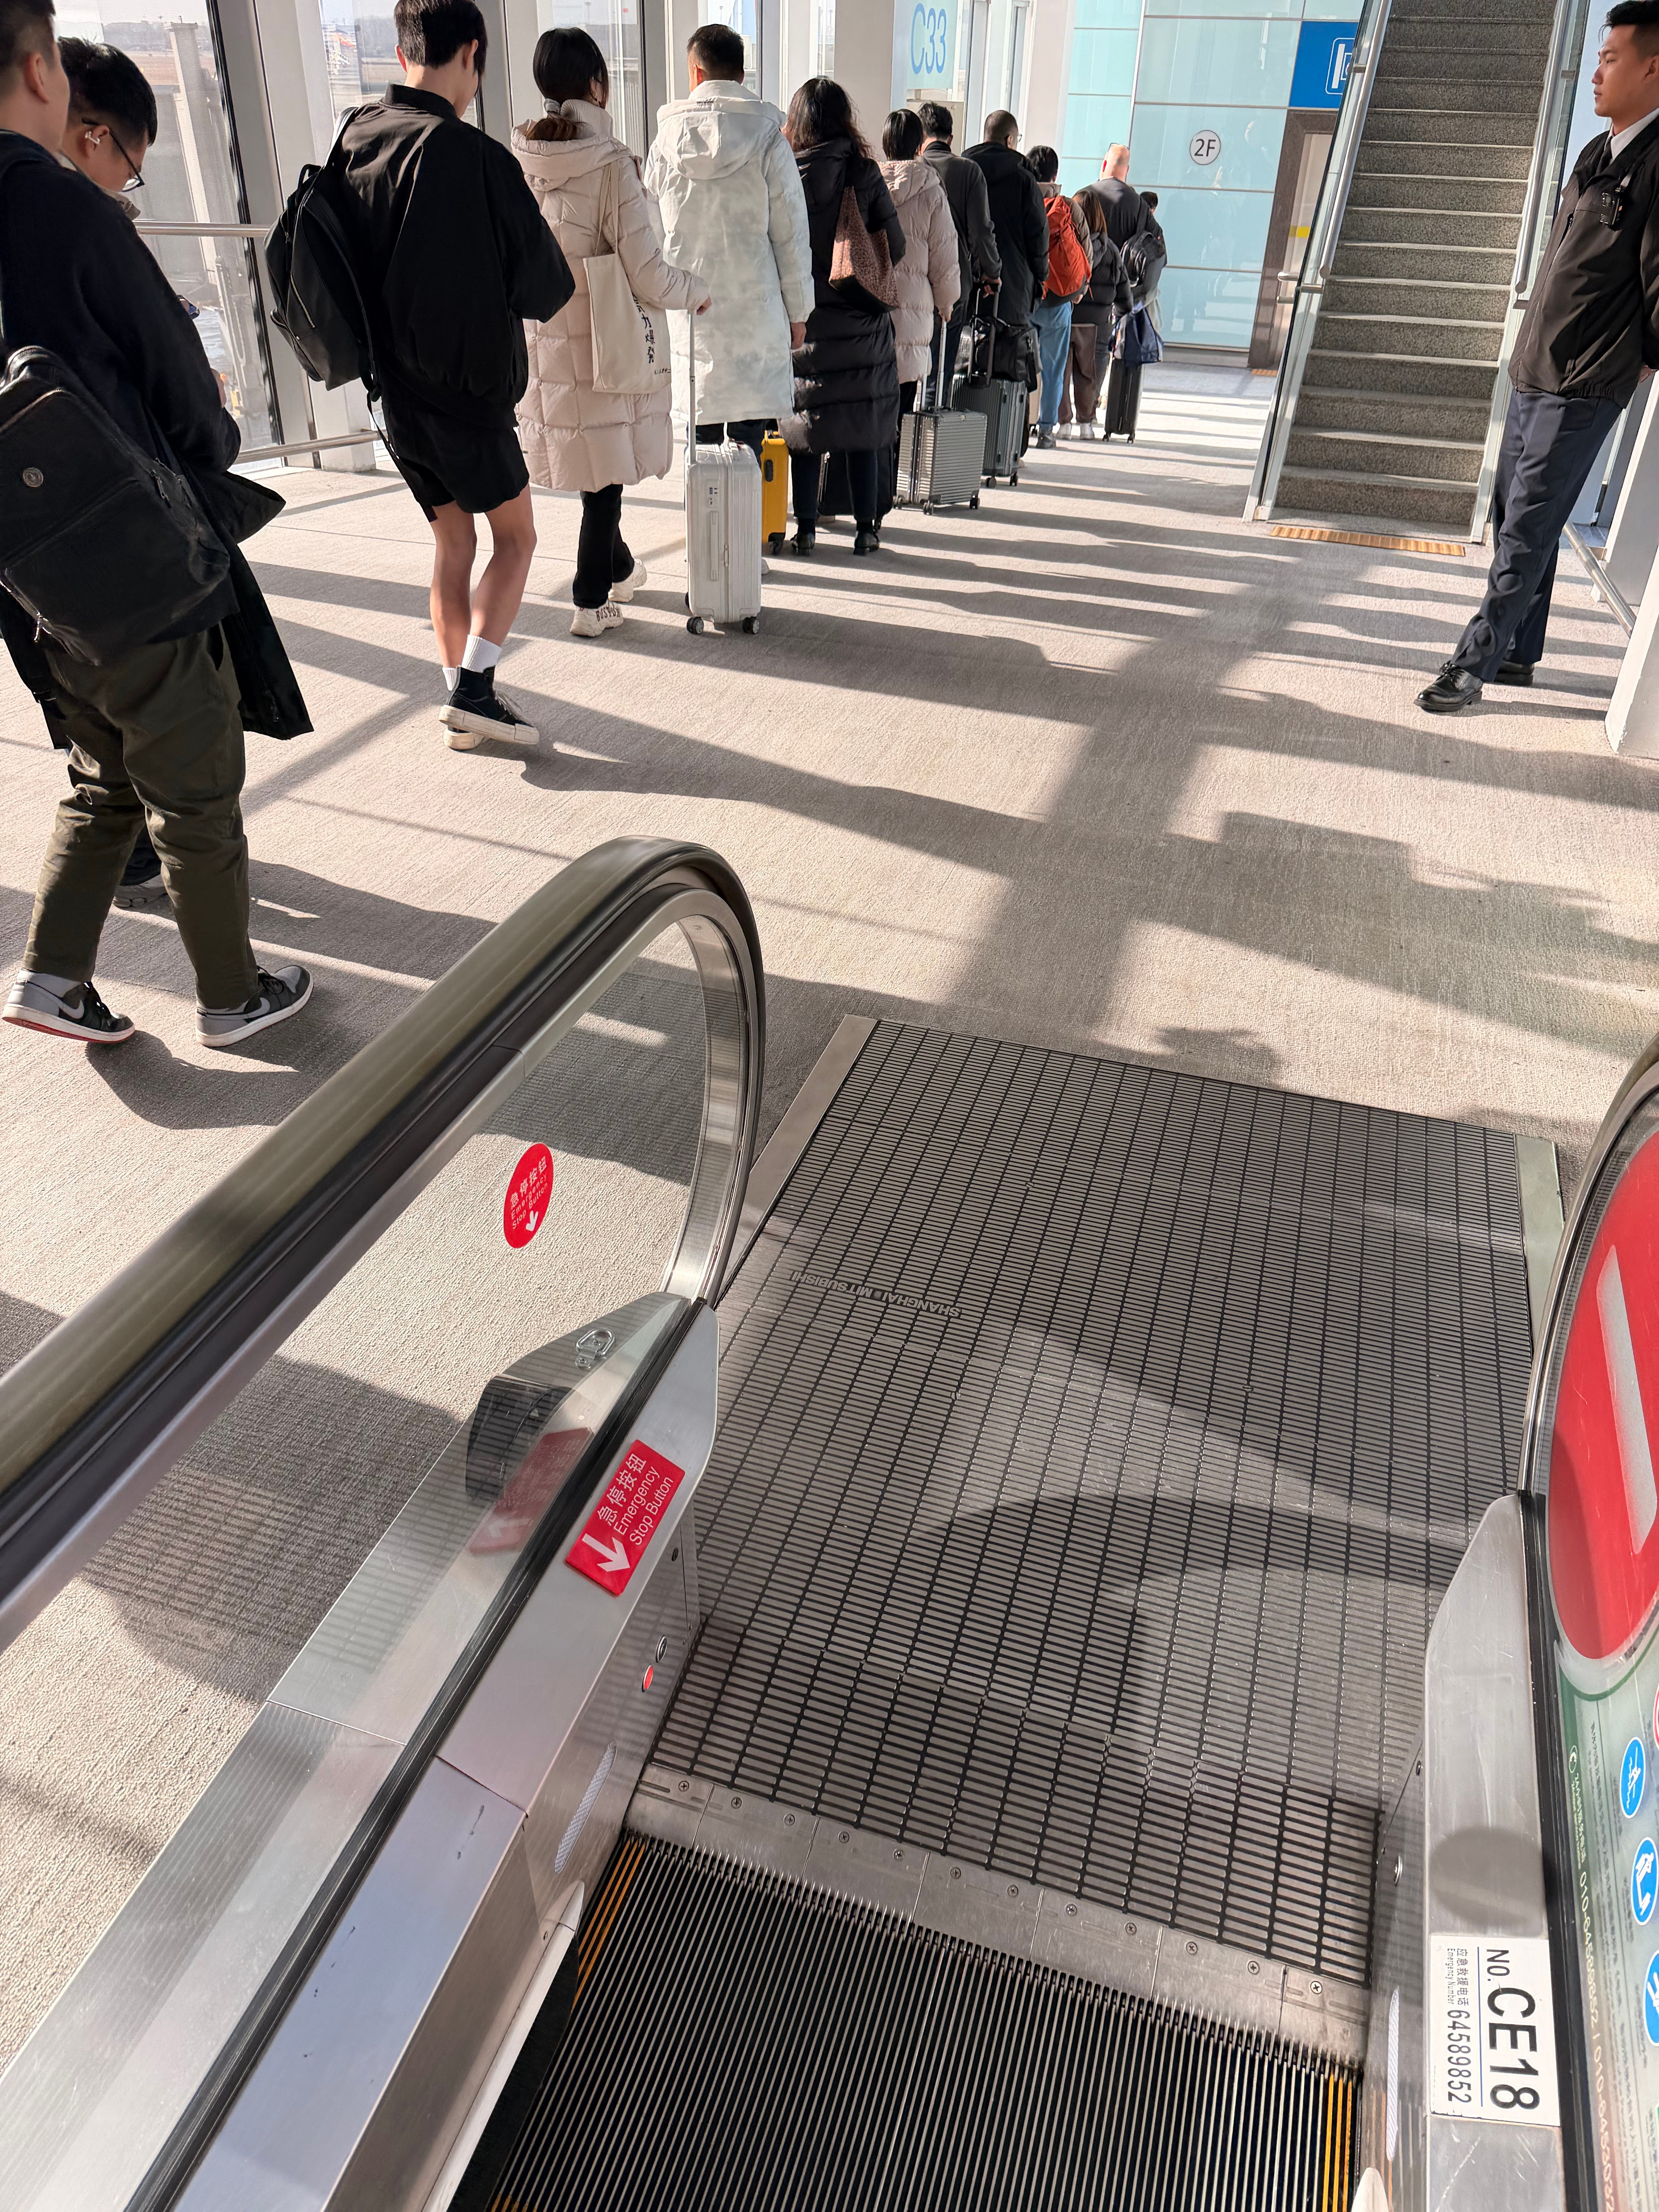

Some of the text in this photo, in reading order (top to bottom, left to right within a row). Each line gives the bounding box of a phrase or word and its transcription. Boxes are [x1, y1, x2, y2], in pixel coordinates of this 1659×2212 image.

[910, 3, 947, 75] C33
[1194, 138, 1216, 157] 2F
[510, 1156, 547, 1210] 急停按钮
[511, 1172, 547, 1220] Emergency
[512, 1182, 548, 1229] Stop Button
[792, 1271, 962, 1317] SHANGHAI MITSUBISHI
[597, 1453, 647, 1526] 急停按钮
[613, 1466, 660, 1535] Emergency
[630, 1477, 674, 1545] Stop Button
[1446, 1948, 1455, 1980] Emergency
[1447, 1948, 1472, 2103] 应急救援电话 64589852
[1486, 1949, 1540, 2110] NO. CE18
